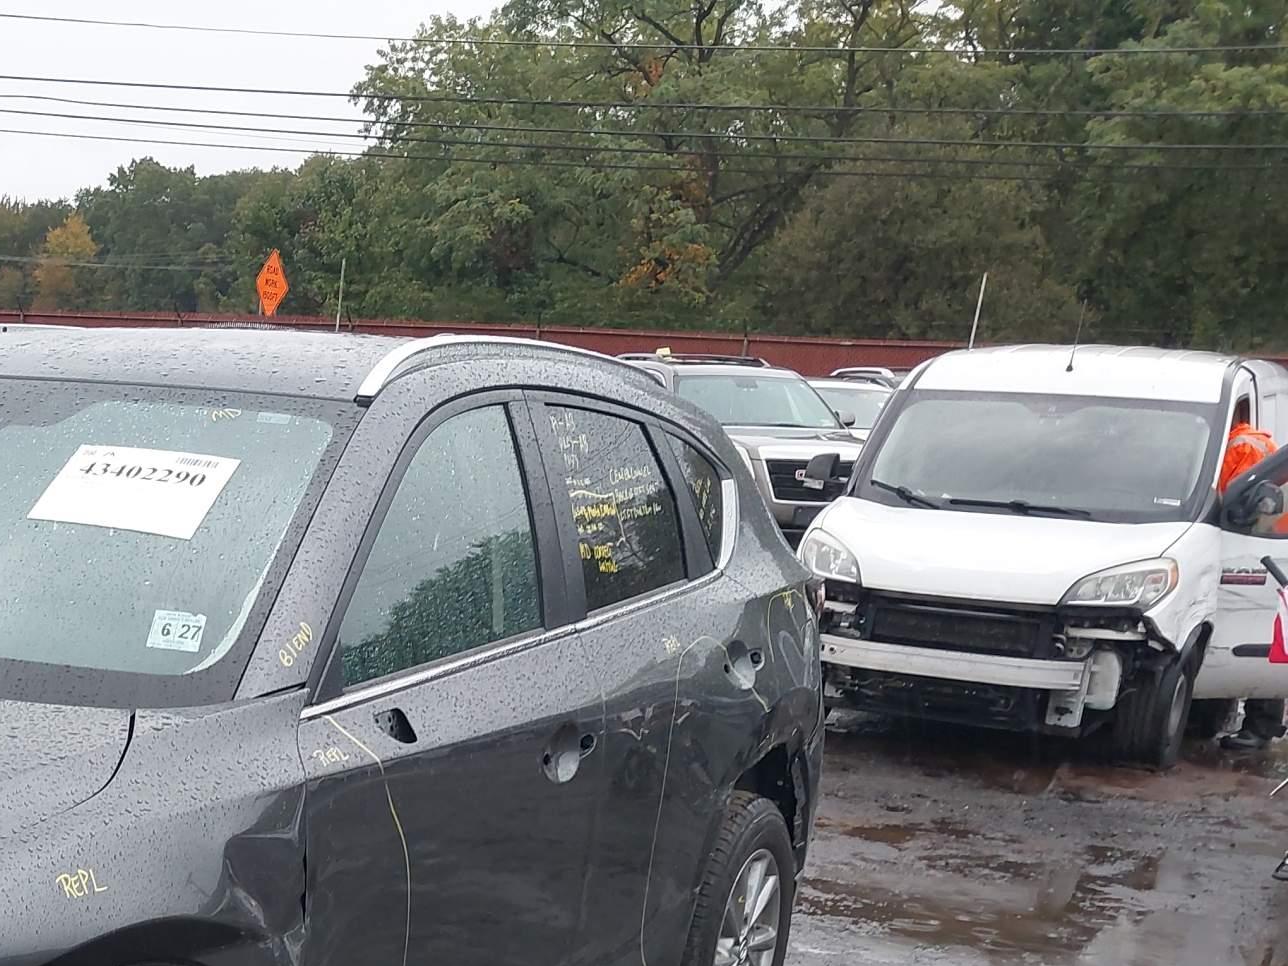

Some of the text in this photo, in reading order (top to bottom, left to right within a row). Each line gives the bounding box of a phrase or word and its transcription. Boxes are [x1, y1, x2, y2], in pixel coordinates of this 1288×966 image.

[79, 461, 207, 487] 43402290
[161, 622, 202, 641] 6 27
[55, 868, 109, 899] REPL
